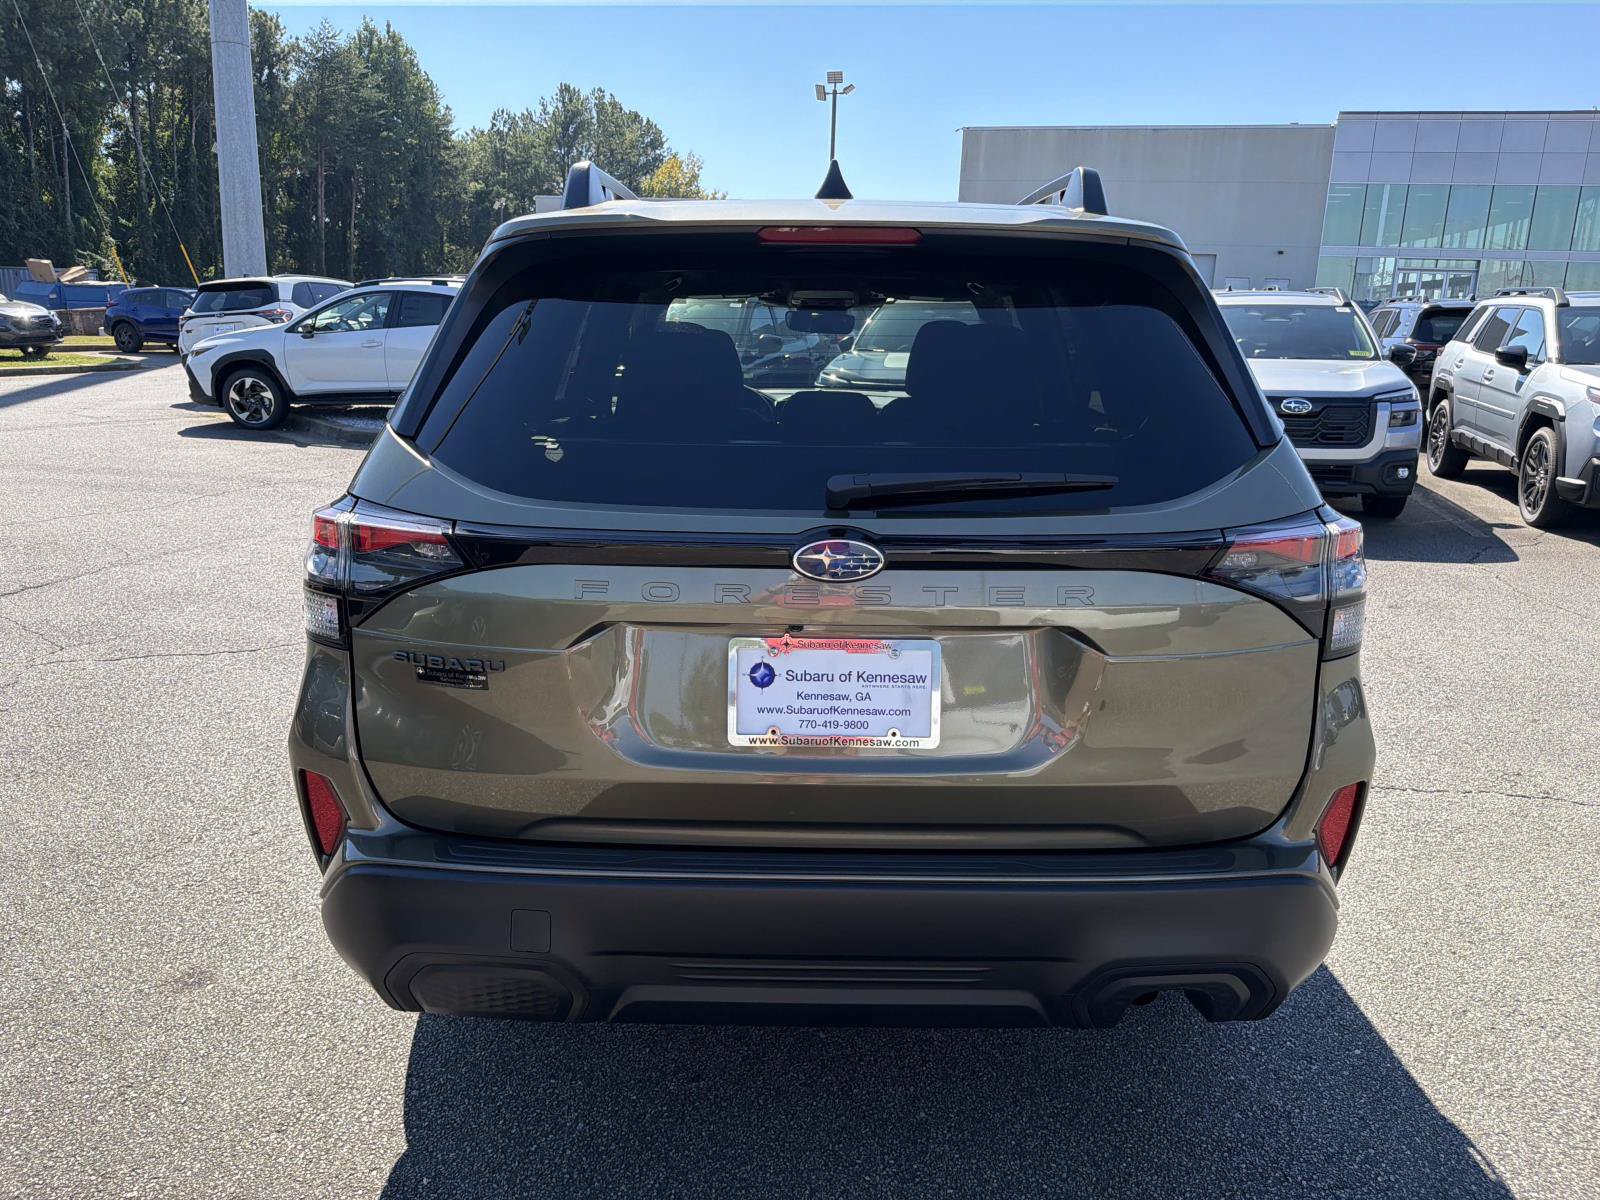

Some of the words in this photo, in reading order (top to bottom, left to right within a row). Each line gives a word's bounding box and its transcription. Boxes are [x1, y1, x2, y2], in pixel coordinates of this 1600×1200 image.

[574, 579, 1096, 606] FORESTER
[797, 640, 831, 650] Subaru
[833, 640, 845, 649] of
[846, 640, 892, 650] Kennesaw
[392, 649, 505, 673] SUBARU
[785, 669, 834, 683] Subaru
[838, 670, 852, 683] of
[856, 671, 927, 684] Kennesaw
[796, 691, 852, 702] Kennesaw,
[855, 692, 872, 702] GA
[757, 705, 911, 717] www.SubaruofKennesaw.com
[798, 720, 869, 730] 770-419-9800
[748, 736, 920, 748] www.SubaruofKennesaw.com
